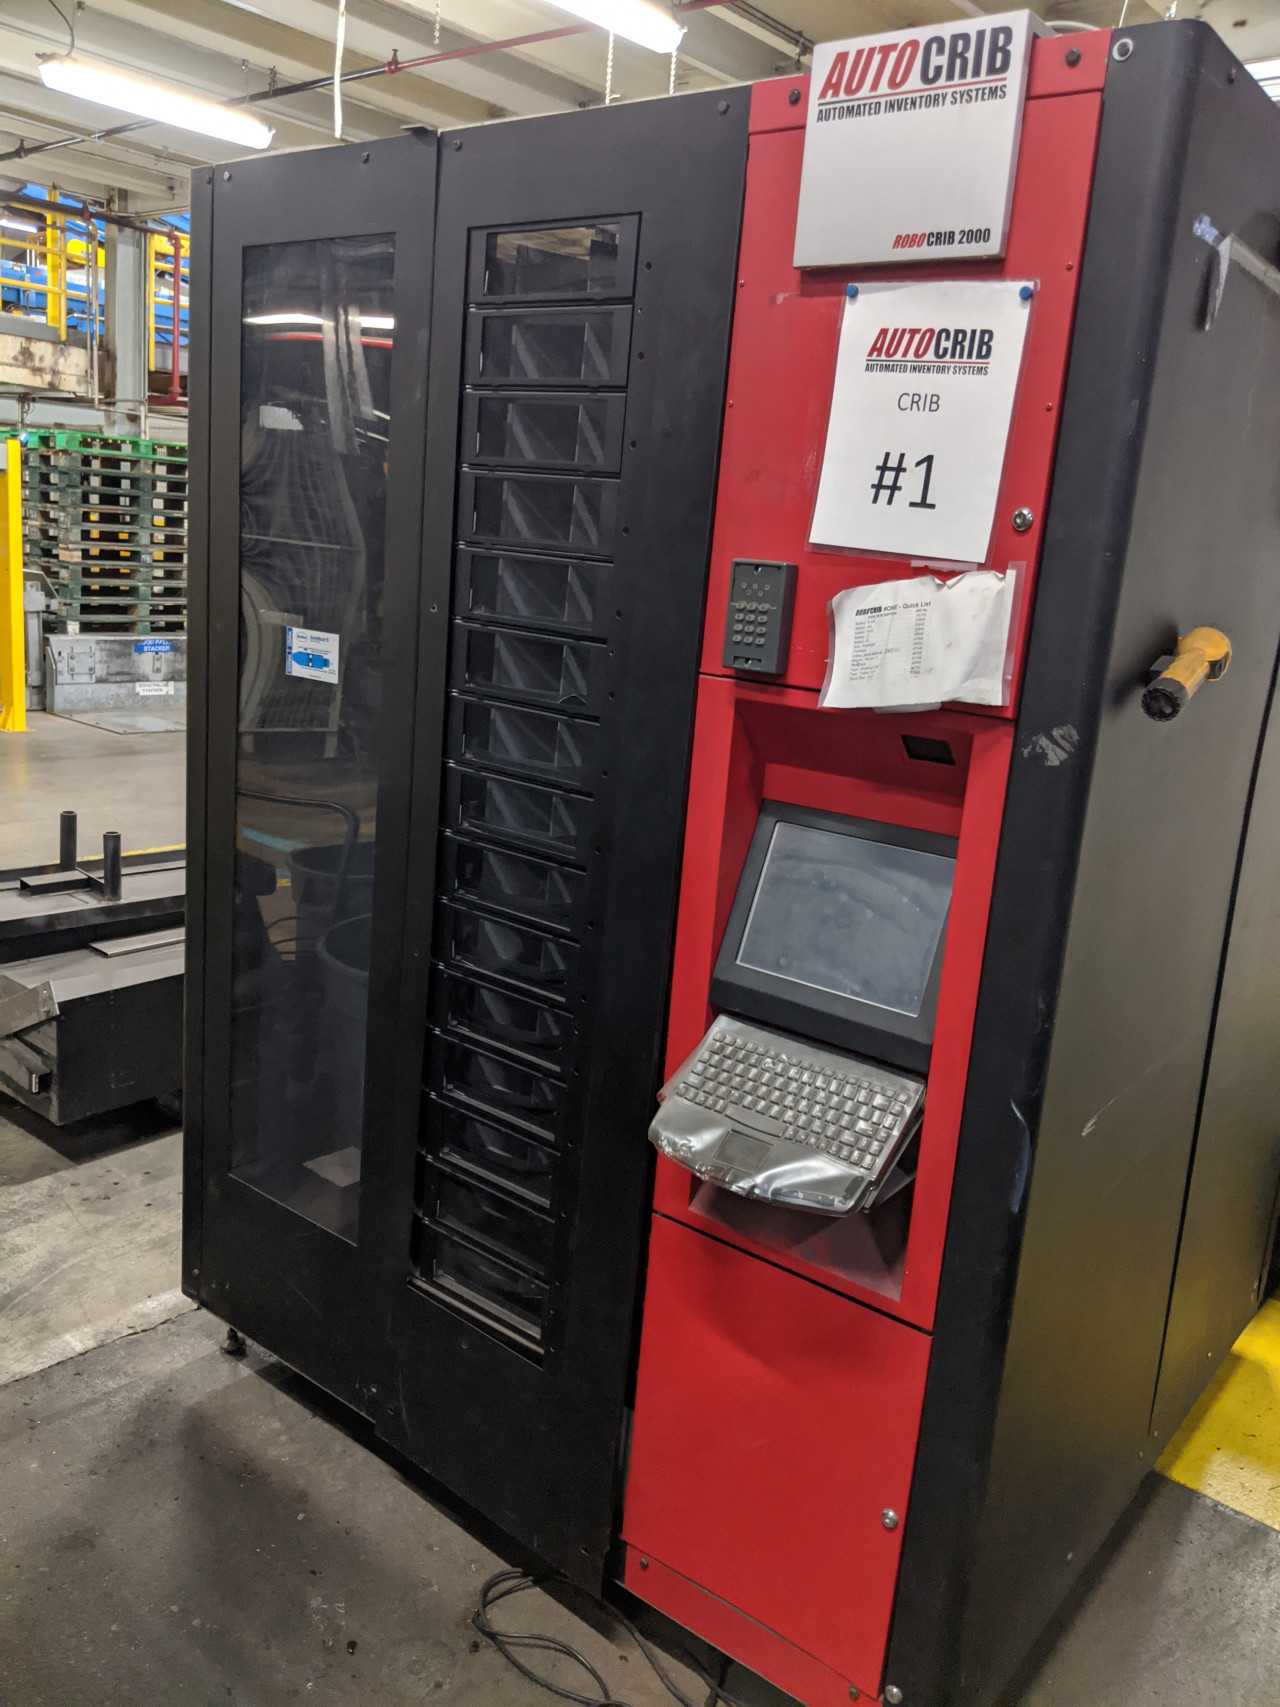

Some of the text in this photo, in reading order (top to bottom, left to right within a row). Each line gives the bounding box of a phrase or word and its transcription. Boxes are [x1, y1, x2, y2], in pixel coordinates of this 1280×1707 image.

[817, 25, 1013, 100] AUTOCRIB
[817, 84, 1007, 123] AUTOMATED INVENTORY SYSTEMS
[892, 228, 991, 249] ROBOCRIB 2000
[867, 327, 994, 360] AUTOCRIB
[865, 362, 989, 376] AUTOMATED INVENTORY SYSTEMS
[897, 392, 941, 412] CRIB
[870, 451, 937, 510] #1
